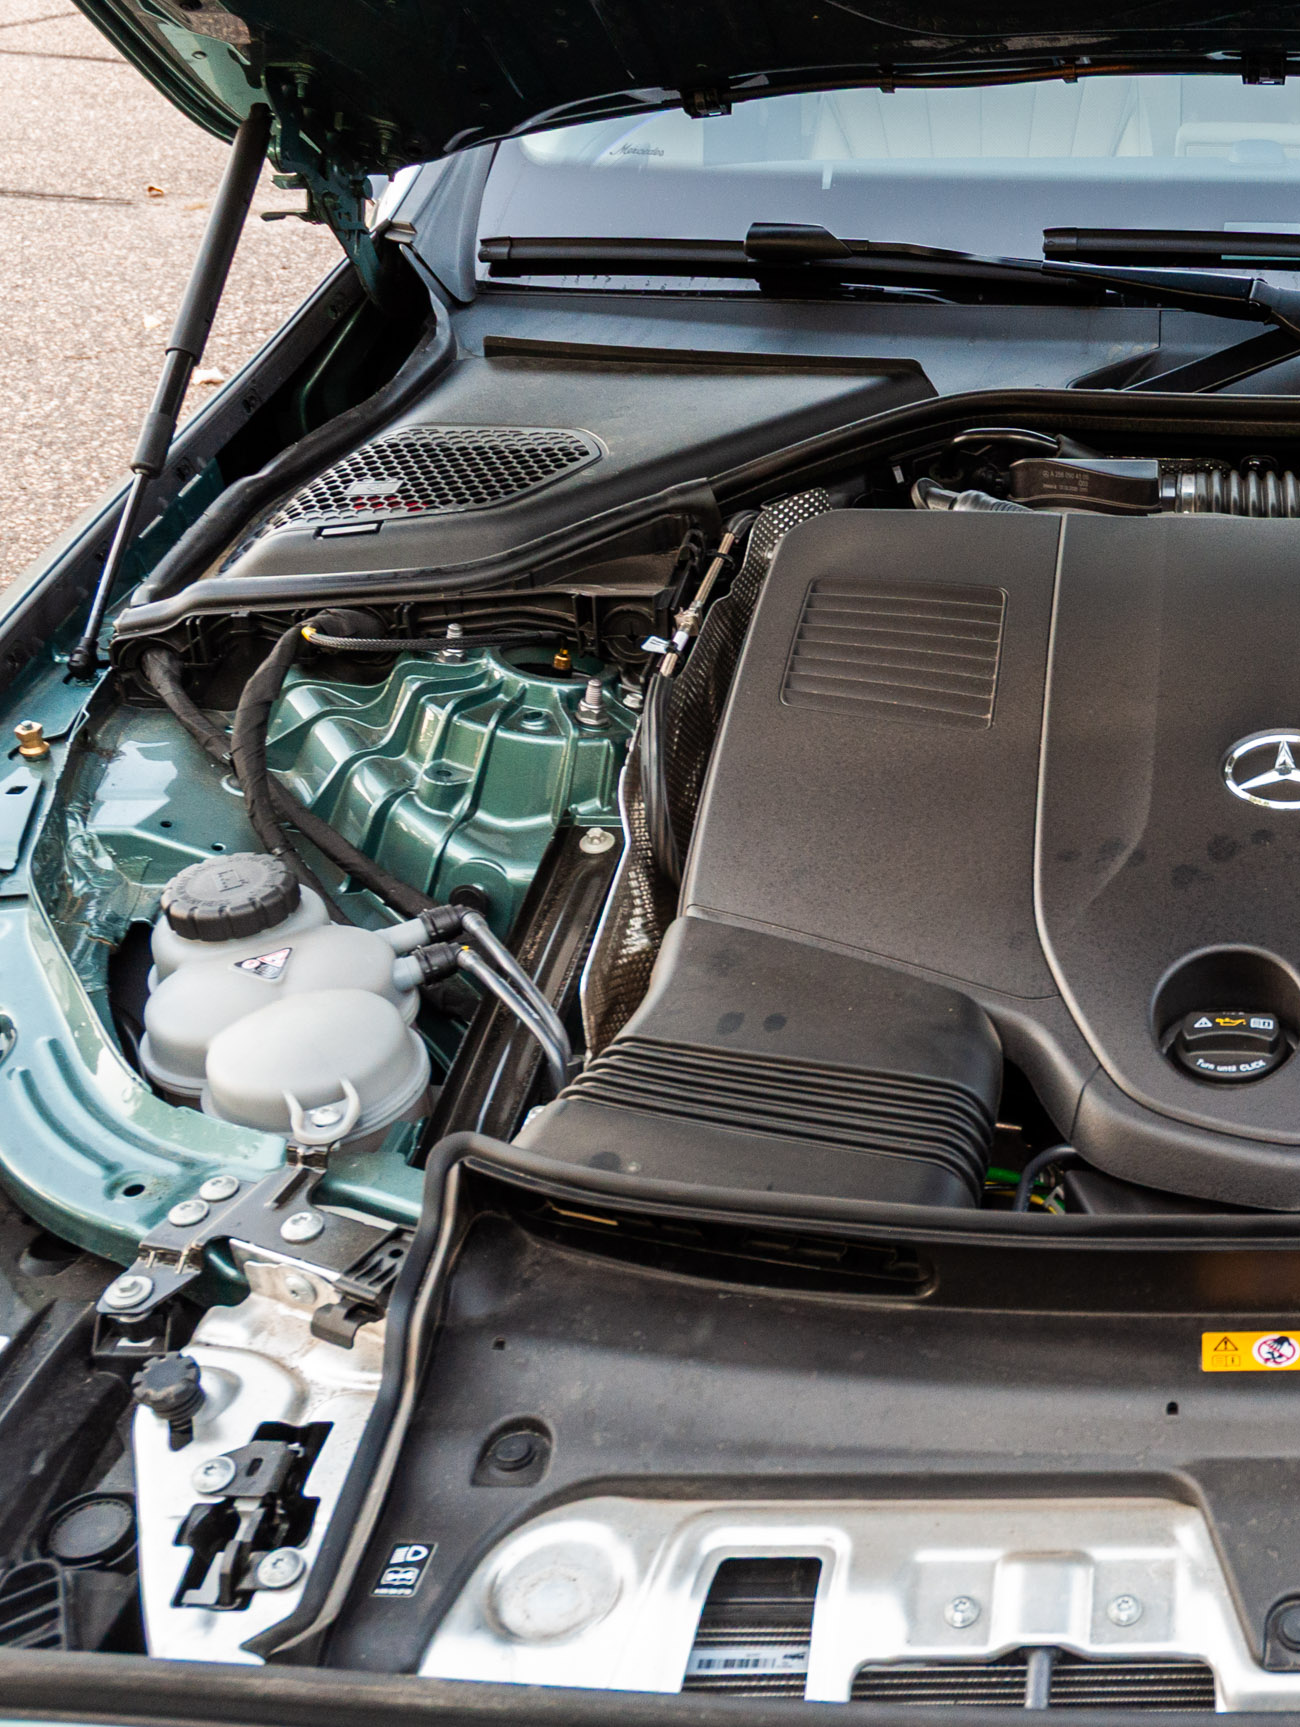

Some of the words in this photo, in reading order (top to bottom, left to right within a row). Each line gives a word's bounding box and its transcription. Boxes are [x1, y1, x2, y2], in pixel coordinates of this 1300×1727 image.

[1196, 1058, 1215, 1070] Turn
[1217, 1064, 1237, 1072] until
[1239, 1059, 1267, 1072] CLICK
